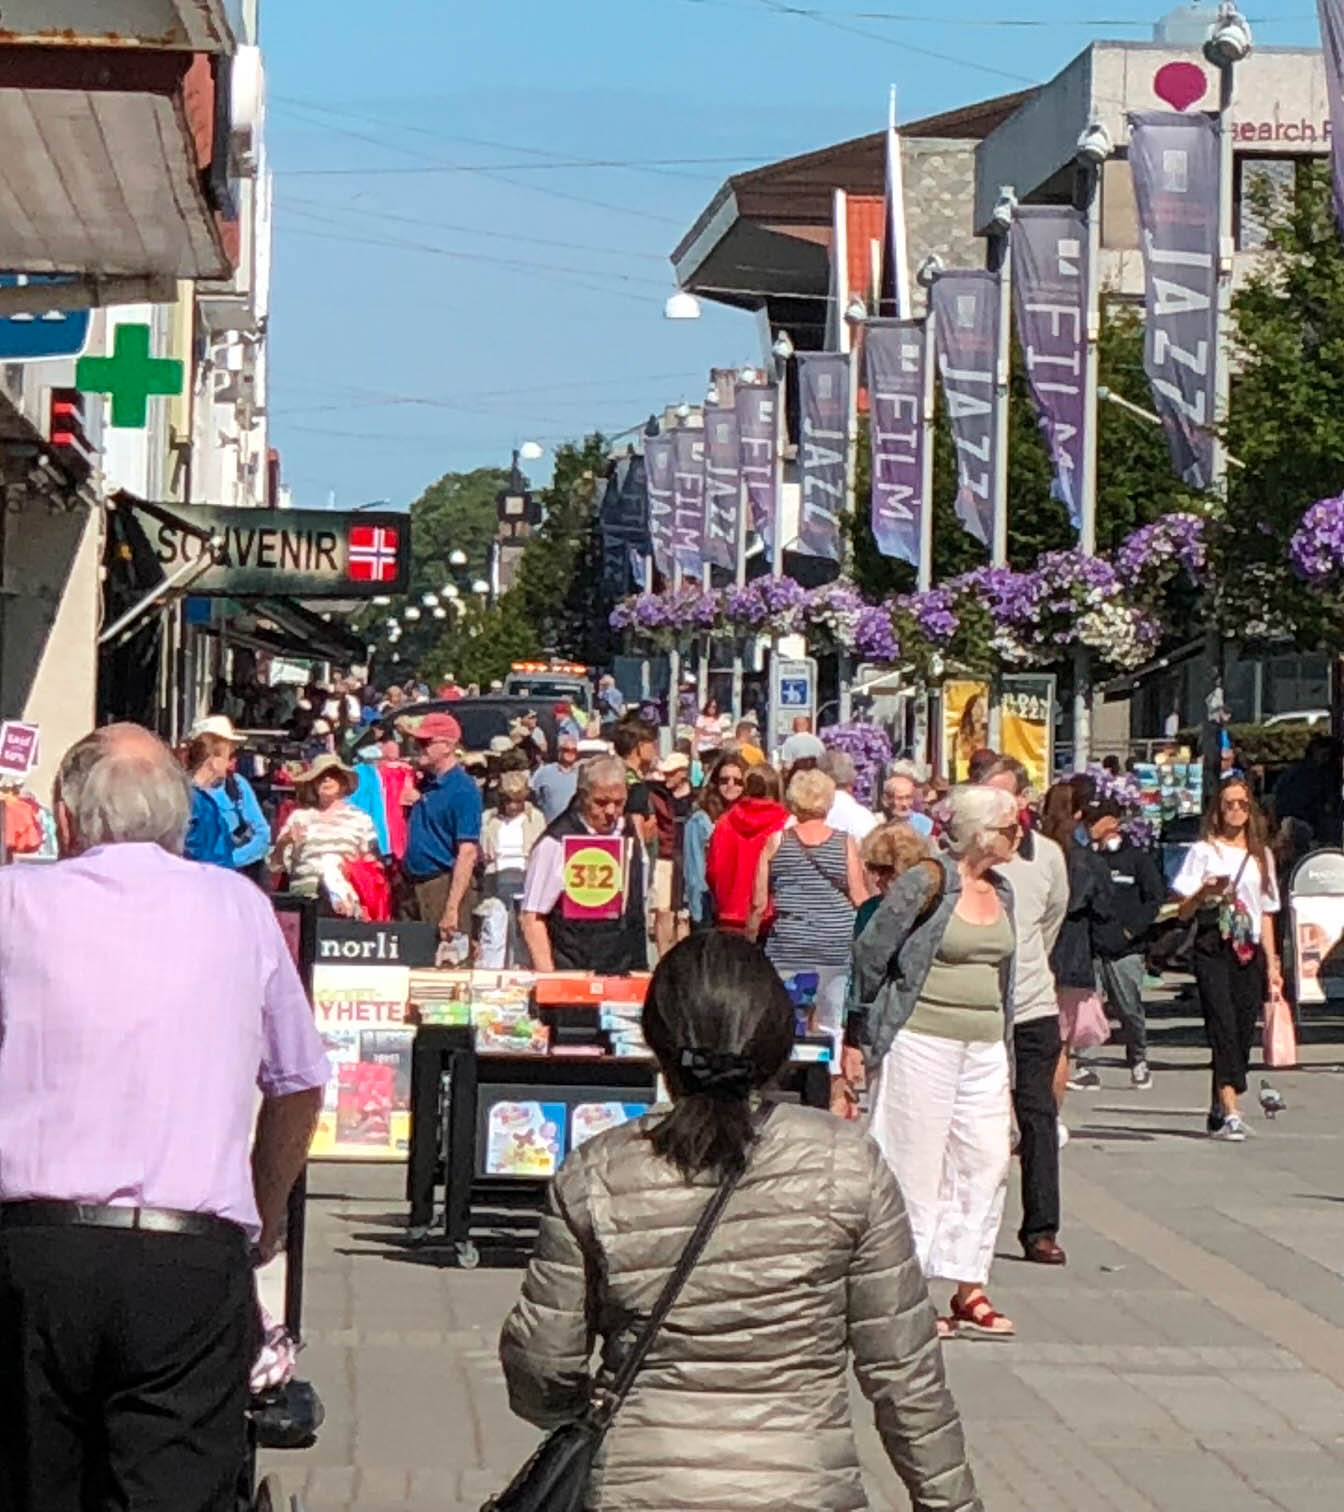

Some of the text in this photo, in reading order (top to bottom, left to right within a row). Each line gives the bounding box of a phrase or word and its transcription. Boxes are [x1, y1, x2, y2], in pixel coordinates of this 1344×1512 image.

[875, 392, 920, 521] FILM
[673, 472, 703, 552] FILM
[157, 522, 339, 571] SOUVENIR
[320, 932, 399, 960] norli
